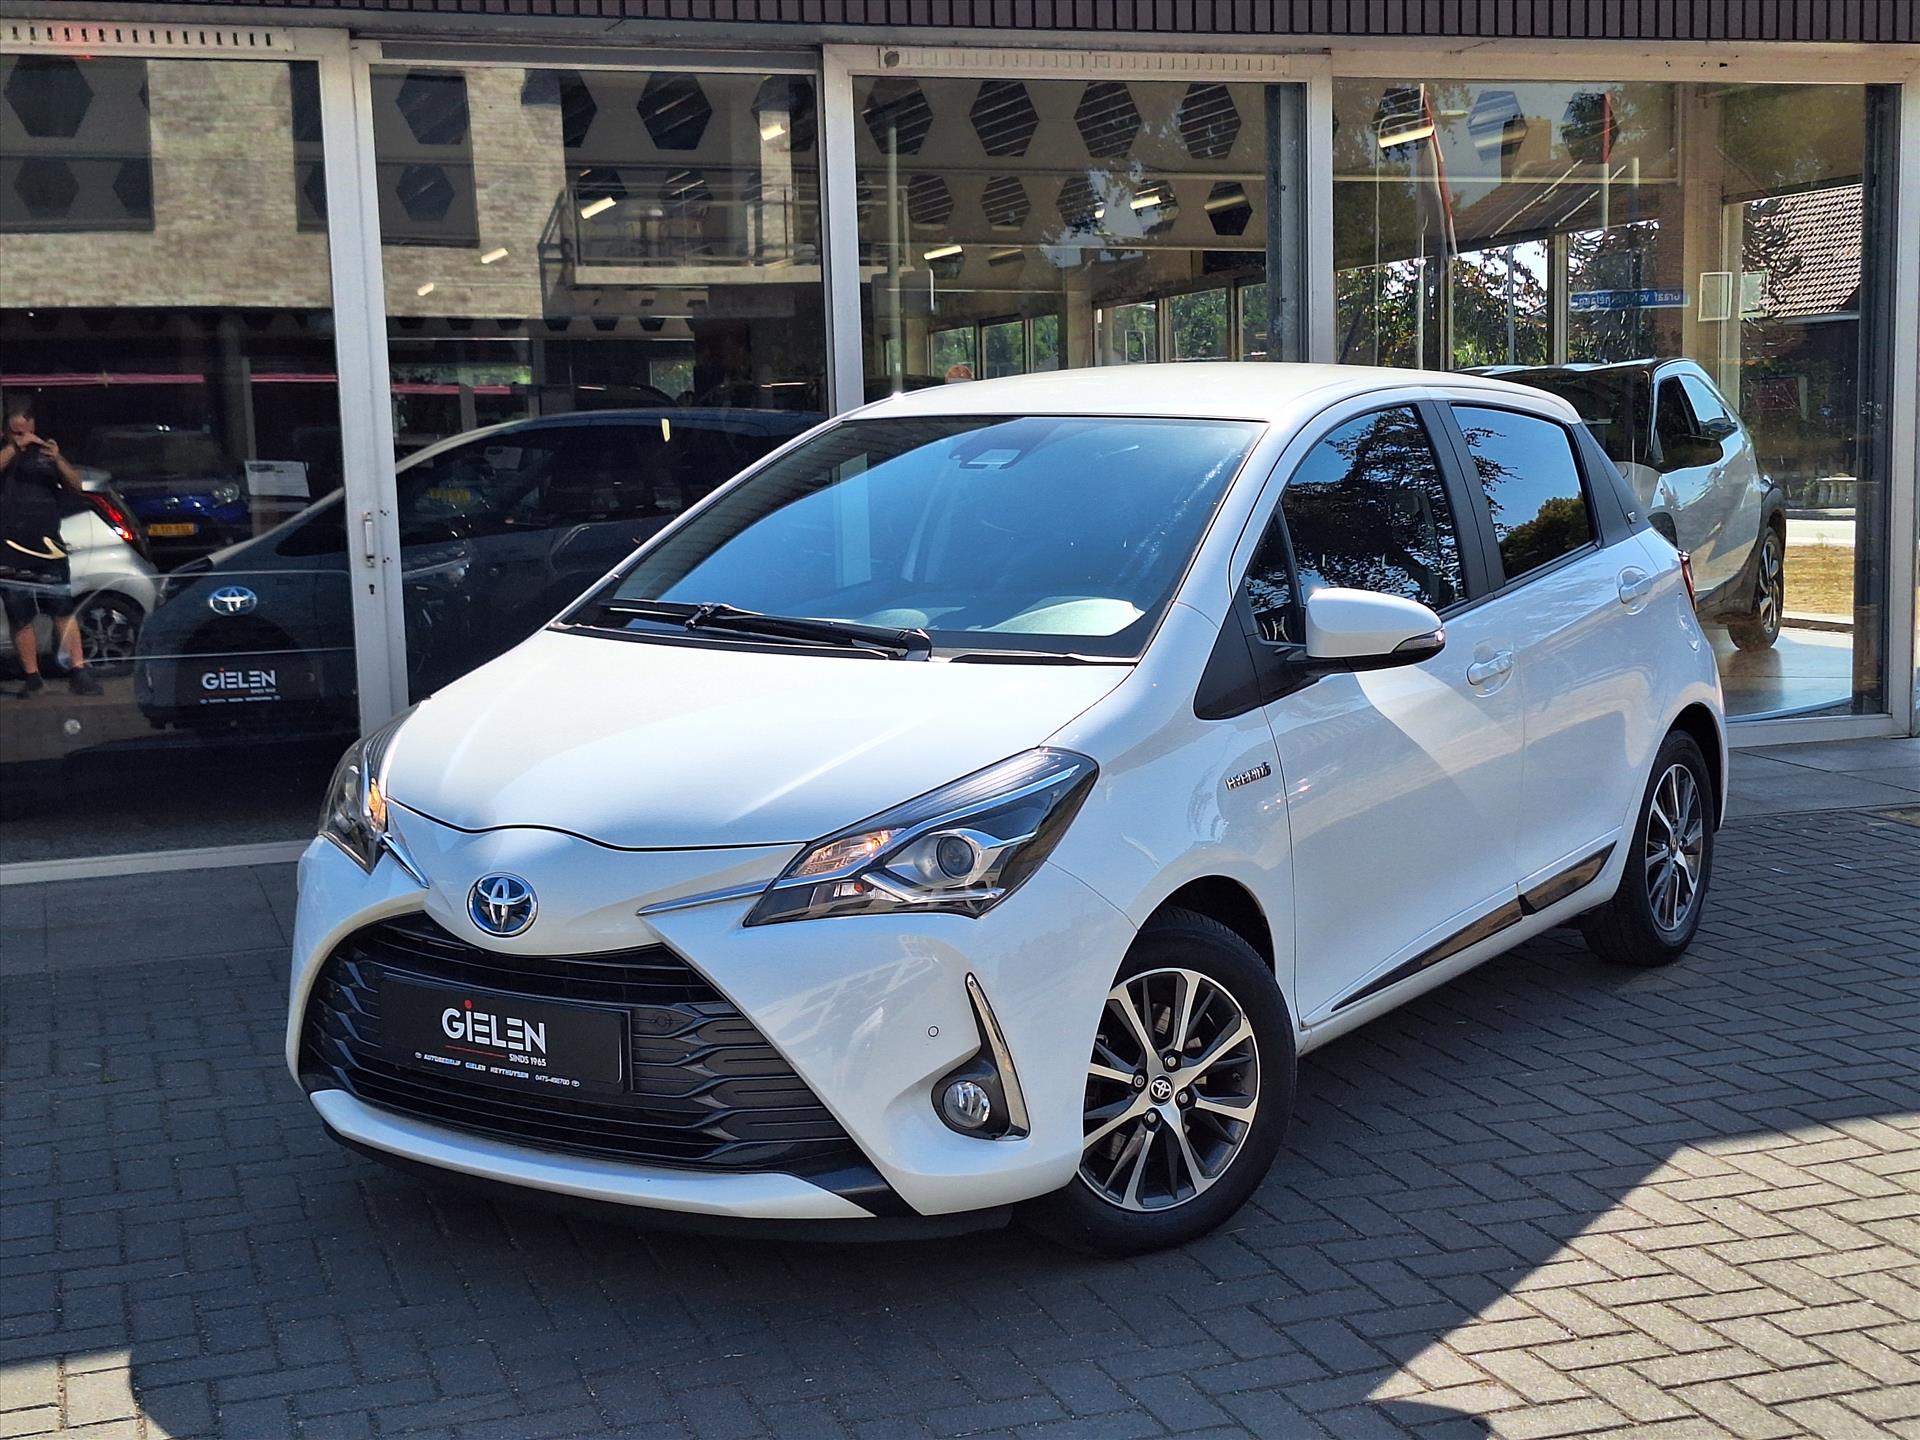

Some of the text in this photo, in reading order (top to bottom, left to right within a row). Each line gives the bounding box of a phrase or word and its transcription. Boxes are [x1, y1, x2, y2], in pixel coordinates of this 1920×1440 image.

[201, 666, 277, 690] GIELEN
[441, 999, 548, 1055] GIELEN
[508, 1053, 547, 1067] SINDS 1965
